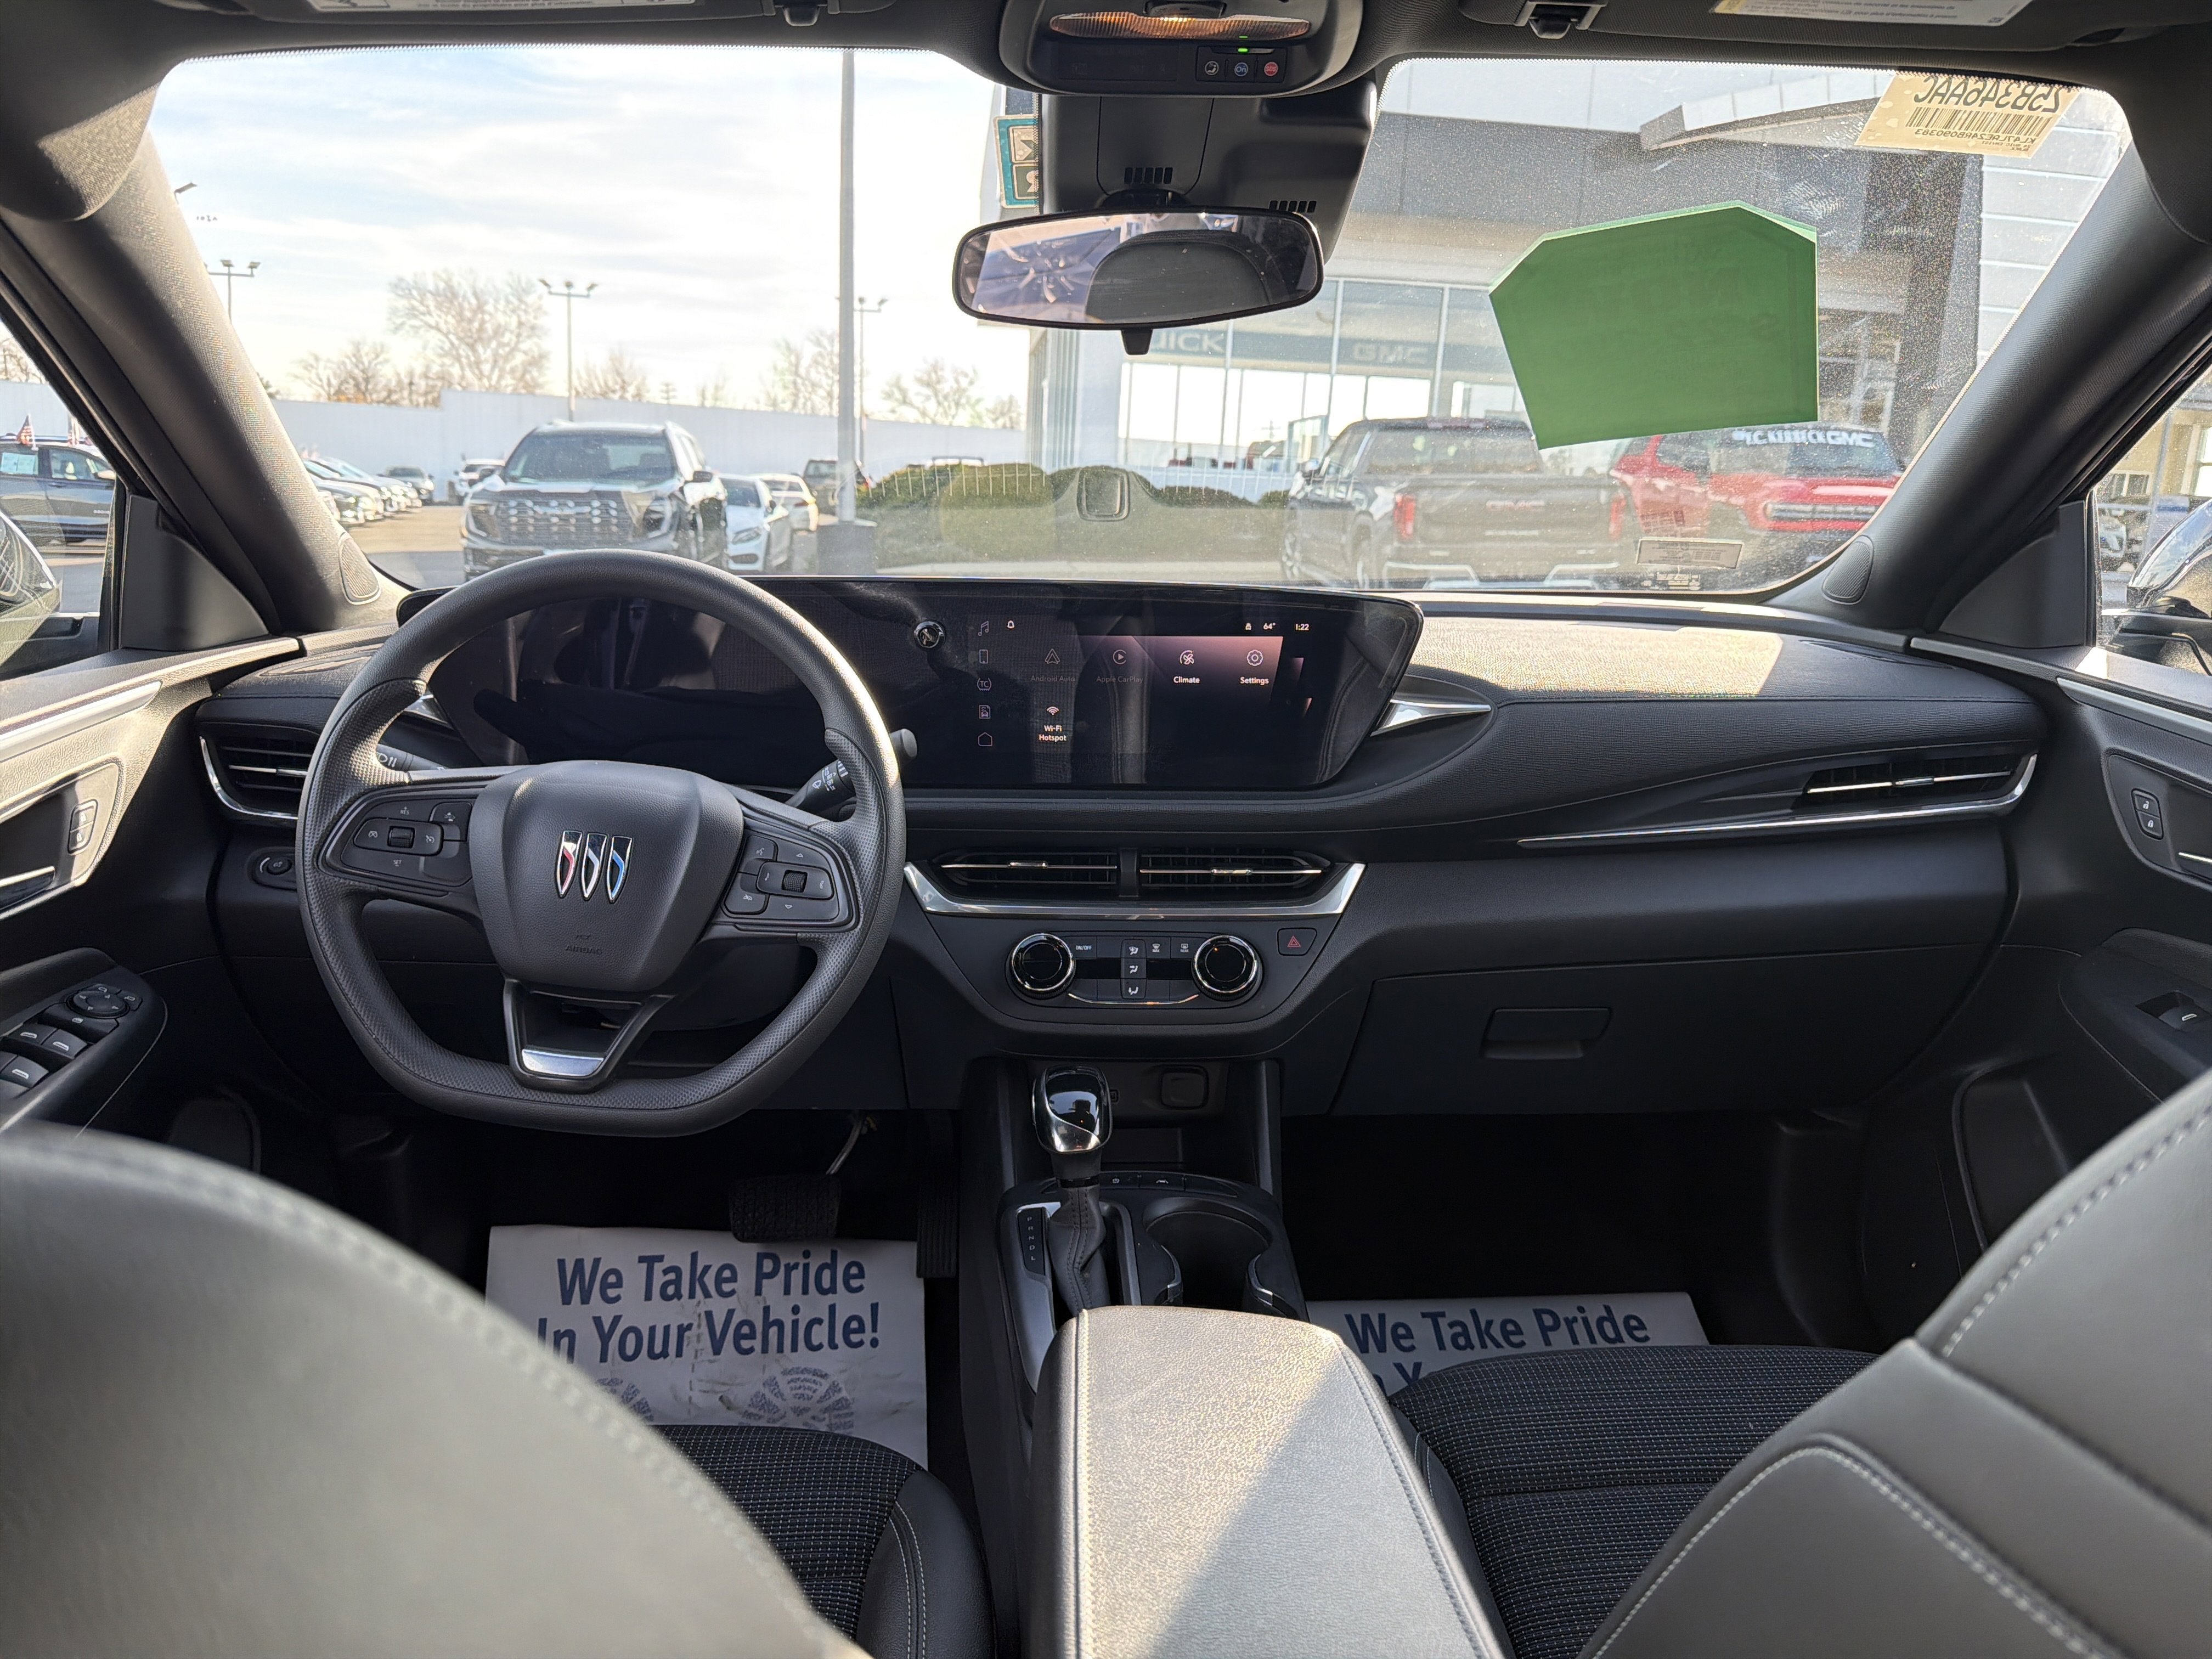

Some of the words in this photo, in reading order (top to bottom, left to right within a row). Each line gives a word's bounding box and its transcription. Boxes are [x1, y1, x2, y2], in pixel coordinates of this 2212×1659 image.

[1352, 343, 1429, 365] GMC
[1263, 622, 1277, 631] 64°
[1294, 623, 1310, 631] 1:22
[1030, 674, 1058, 683] Android
[1059, 674, 1075, 683] Auto
[1096, 675, 1115, 684] Apple
[1117, 675, 1144, 684] CarPlay
[1173, 675, 1200, 685] Climate
[1240, 675, 1269, 686] Settings
[1043, 724, 1062, 733] Wi-Fi
[1038, 733, 1067, 743] Hotspot
[565, 945, 603, 955] AIRBAG
[556, 1256, 624, 1306] We
[637, 1250, 739, 1302] Take
[754, 1248, 866, 1297] Pride
[591, 1314, 693, 1364] Your
[703, 1301, 881, 1357] Vehicle!
[1344, 1312, 1415, 1354] We
[1420, 1307, 1527, 1351] Take
[1532, 1304, 1651, 1347] Pride
